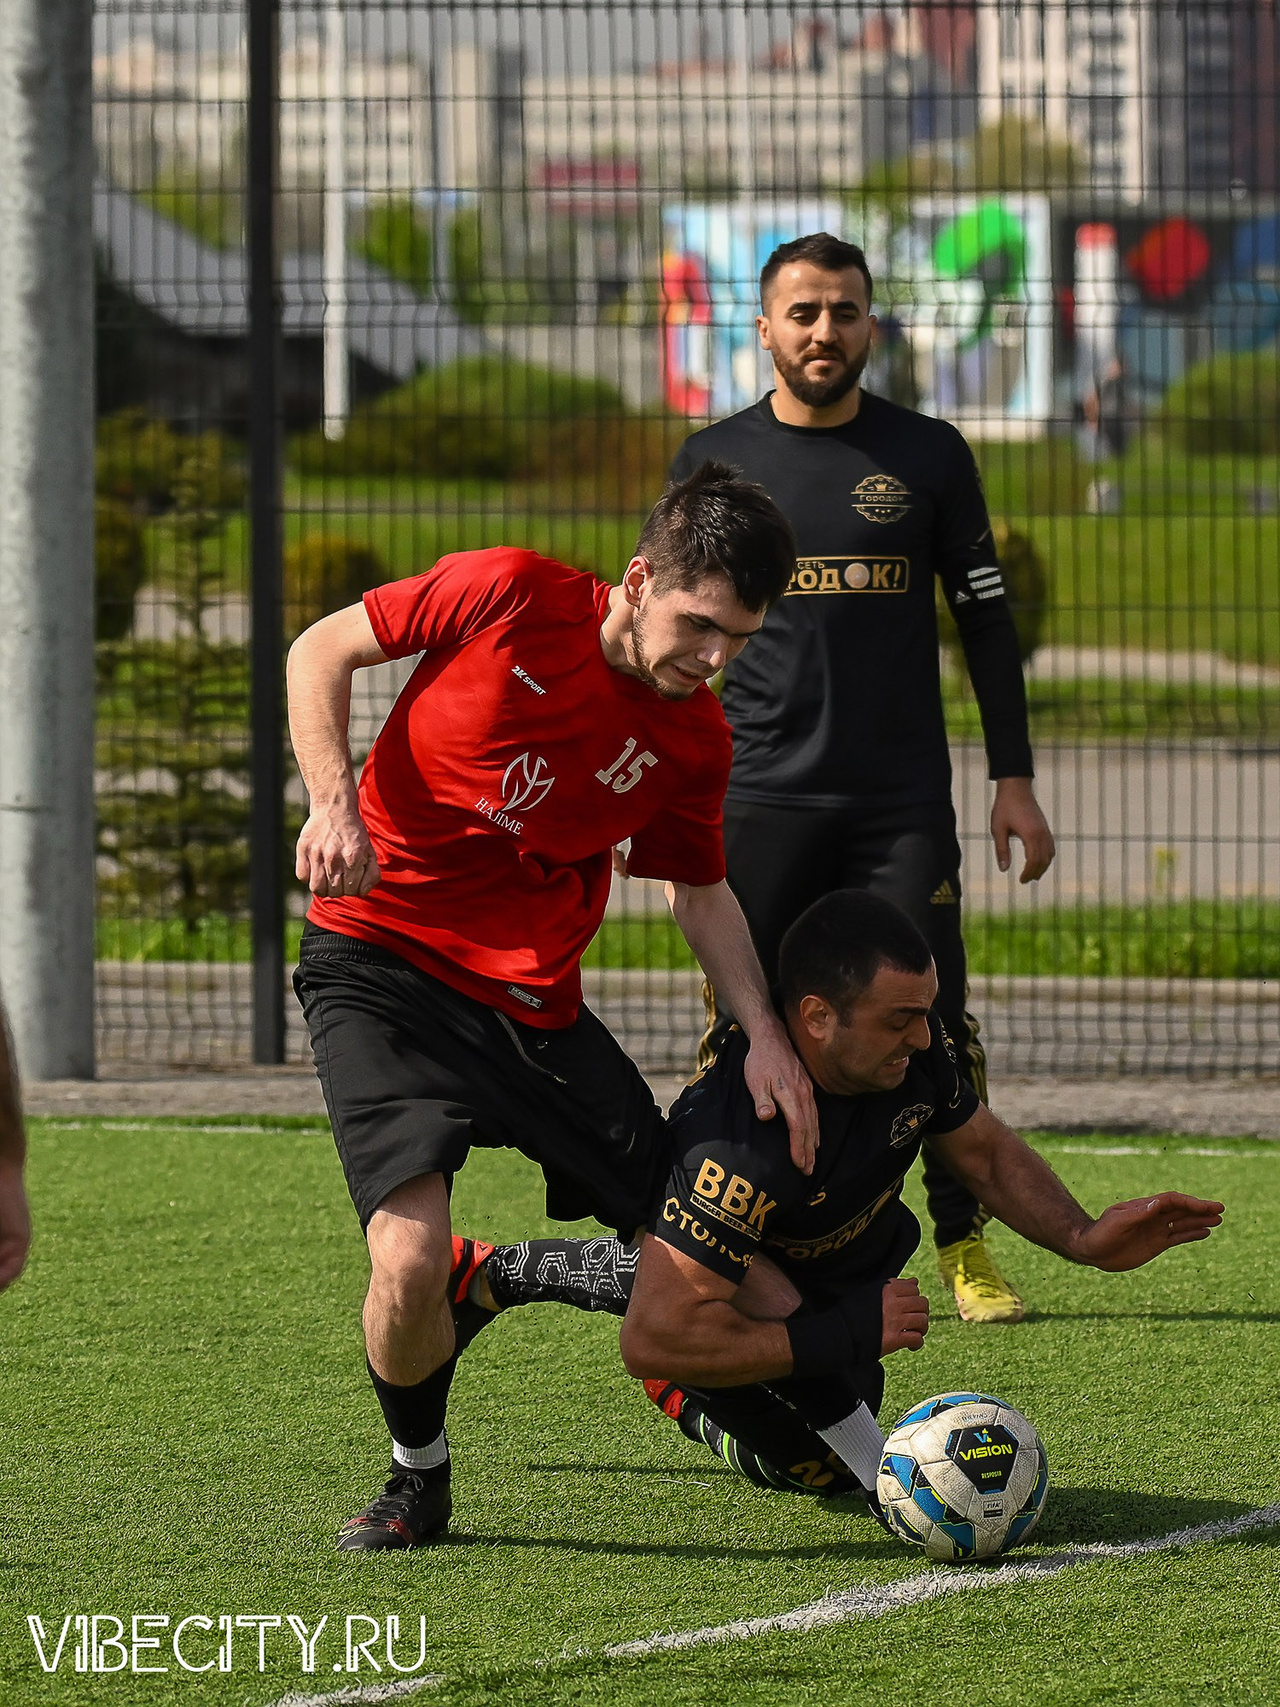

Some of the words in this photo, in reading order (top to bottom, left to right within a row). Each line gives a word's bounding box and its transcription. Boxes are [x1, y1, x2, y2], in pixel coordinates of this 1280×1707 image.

[523, 676, 546, 695] SPORT
[595, 737, 658, 793] 15
[474, 797, 524, 835] HAJIME
[693, 1158, 777, 1231] BBK
[692, 1195, 722, 1221] BURGER
[723, 1214, 743, 1232] BEER
[959, 1444, 1013, 1461] VISION
